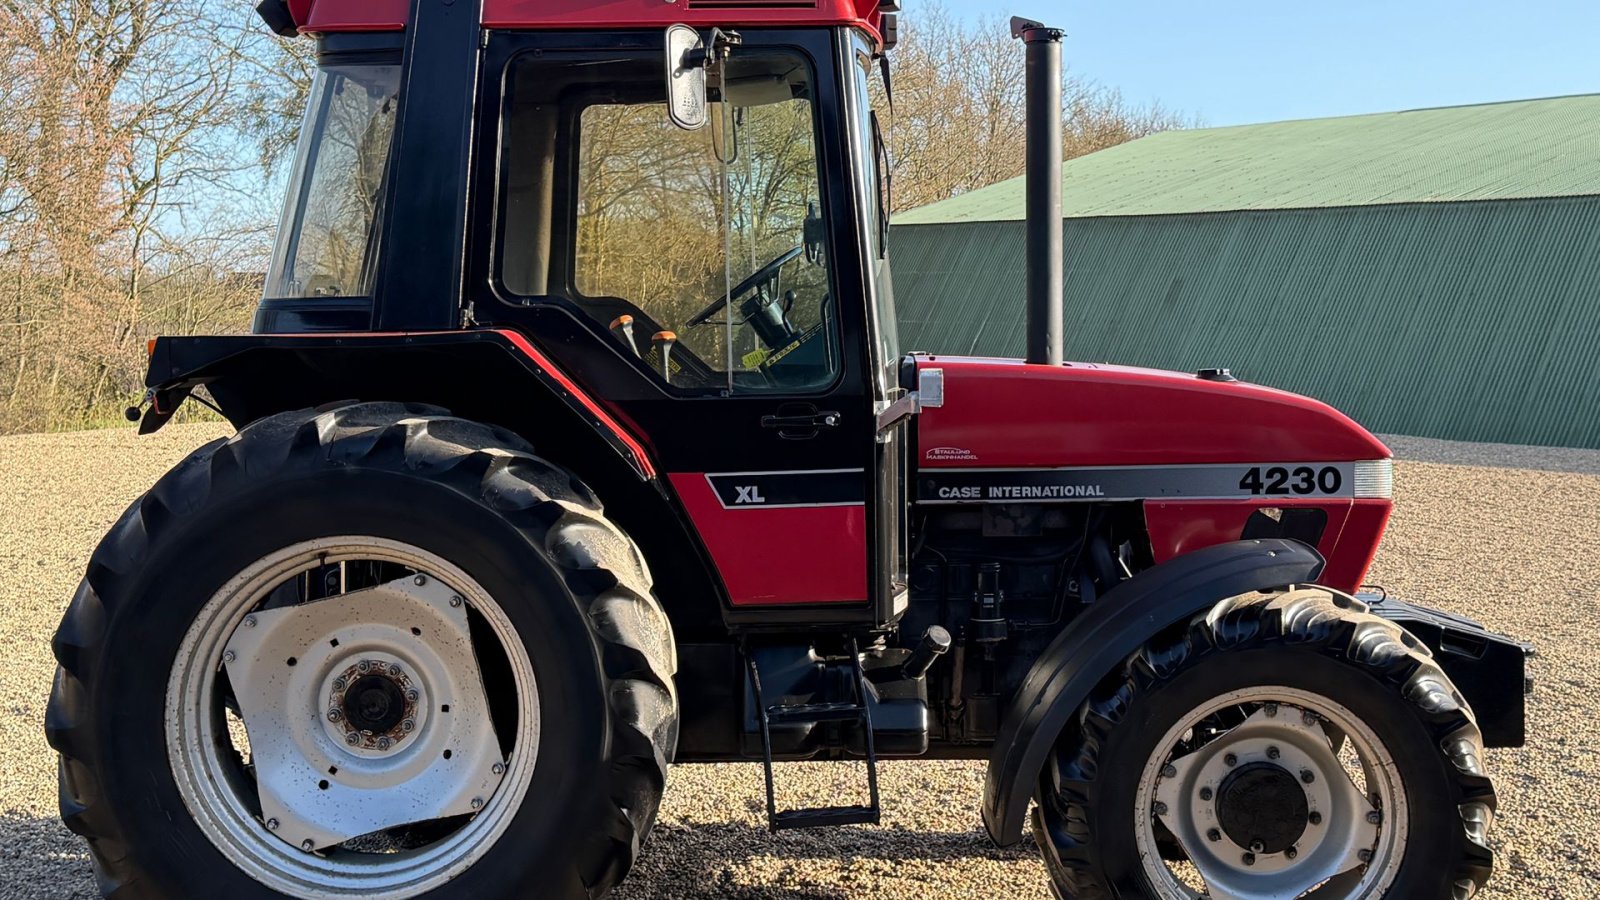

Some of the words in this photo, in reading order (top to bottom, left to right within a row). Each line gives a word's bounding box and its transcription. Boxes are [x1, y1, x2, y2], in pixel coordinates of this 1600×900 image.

[1239, 466, 1342, 495] 4230
[734, 485, 765, 503] XL
[938, 486, 981, 498] CASE
[988, 485, 1105, 498] INTERNATIONAL
